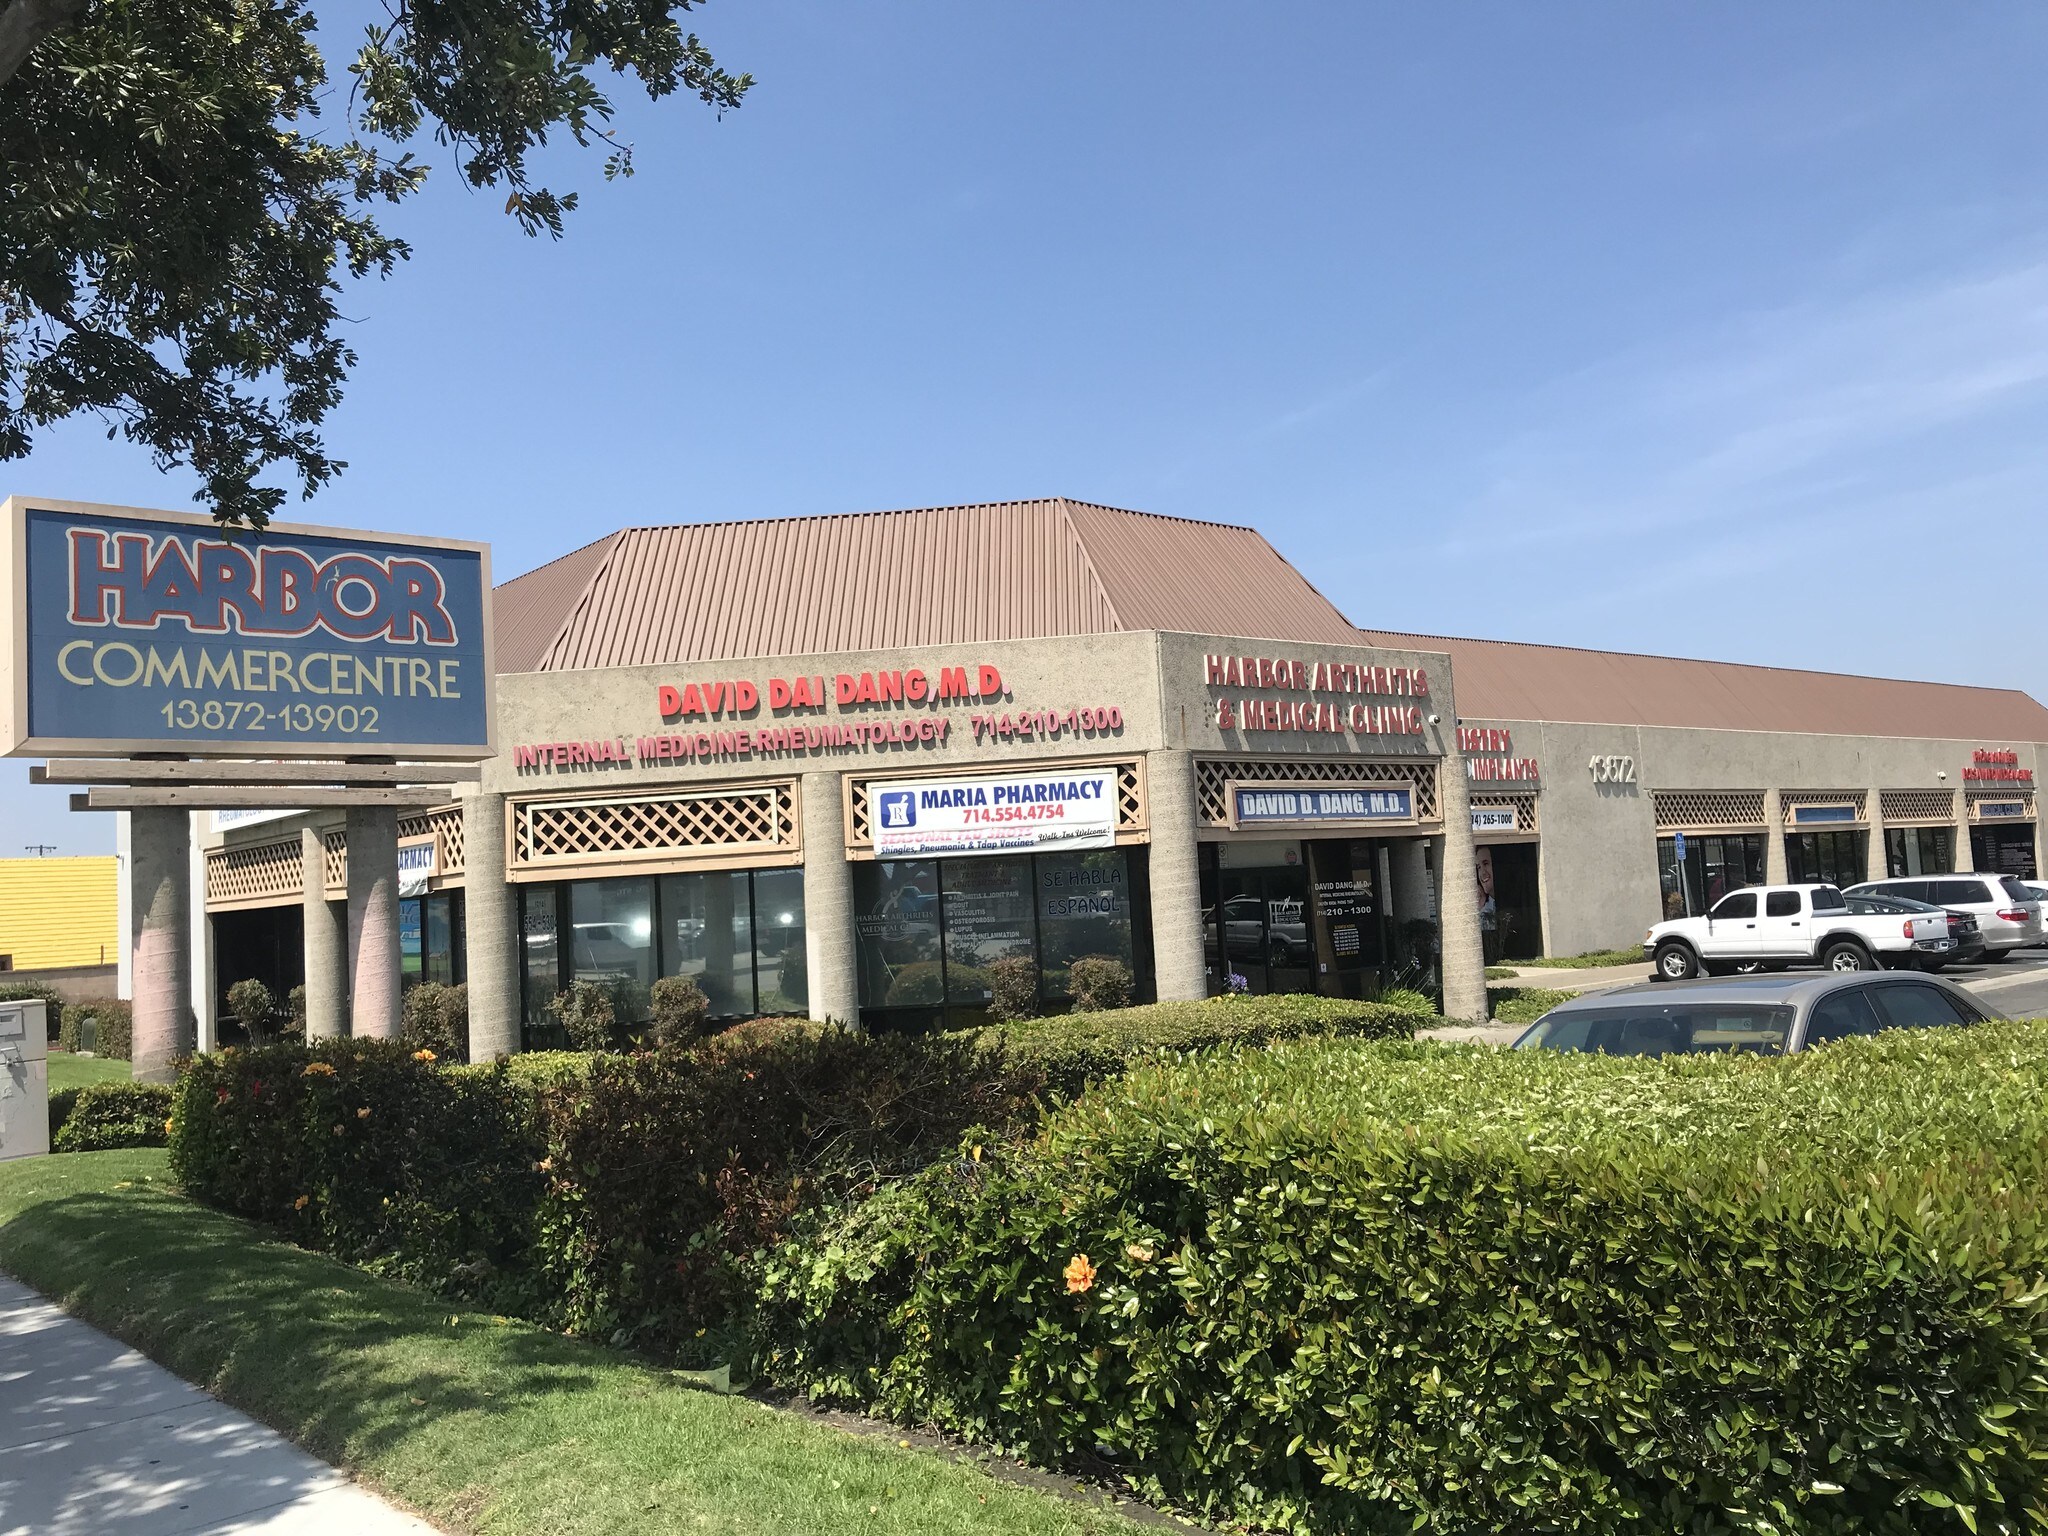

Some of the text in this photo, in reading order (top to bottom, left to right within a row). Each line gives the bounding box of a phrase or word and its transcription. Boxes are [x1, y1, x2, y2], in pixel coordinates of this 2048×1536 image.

[65, 527, 458, 647] HARBOR
[57, 640, 461, 699] COMMERCENTRE
[1204, 654, 1428, 697] HARBOR ARTHRITIS
[659, 681, 759, 716] DAVID
[769, 675, 825, 709] DAI
[161, 700, 379, 733] 13872-13902
[1216, 699, 1423, 735] & MEDICAL CLINIC
[513, 740, 630, 767] INTERNAL
[970, 706, 1122, 737] 714-210-1300
[1471, 758, 1539, 780] IMPLANTS
[1588, 755, 1637, 783] 13872
[921, 780, 1104, 809] MARIA PHARMACY
[1242, 793, 1404, 815] DAVID D. DANG, M.D.
[963, 804, 1064, 824] 714.554.4754
[1471, 814, 1512, 826] 14) 265-1000
[399, 846, 434, 870] ARMACY
[881, 845, 917, 855] Shingles,
[920, 843, 965, 852] Pneumonia
[977, 841, 997, 850] Tdap
[1000, 838, 1034, 848] Vaccines
[1043, 868, 1121, 888] SE HABLA
[1314, 882, 1334, 890] DAVID
[1048, 891, 1120, 915] ESPAÑOL
